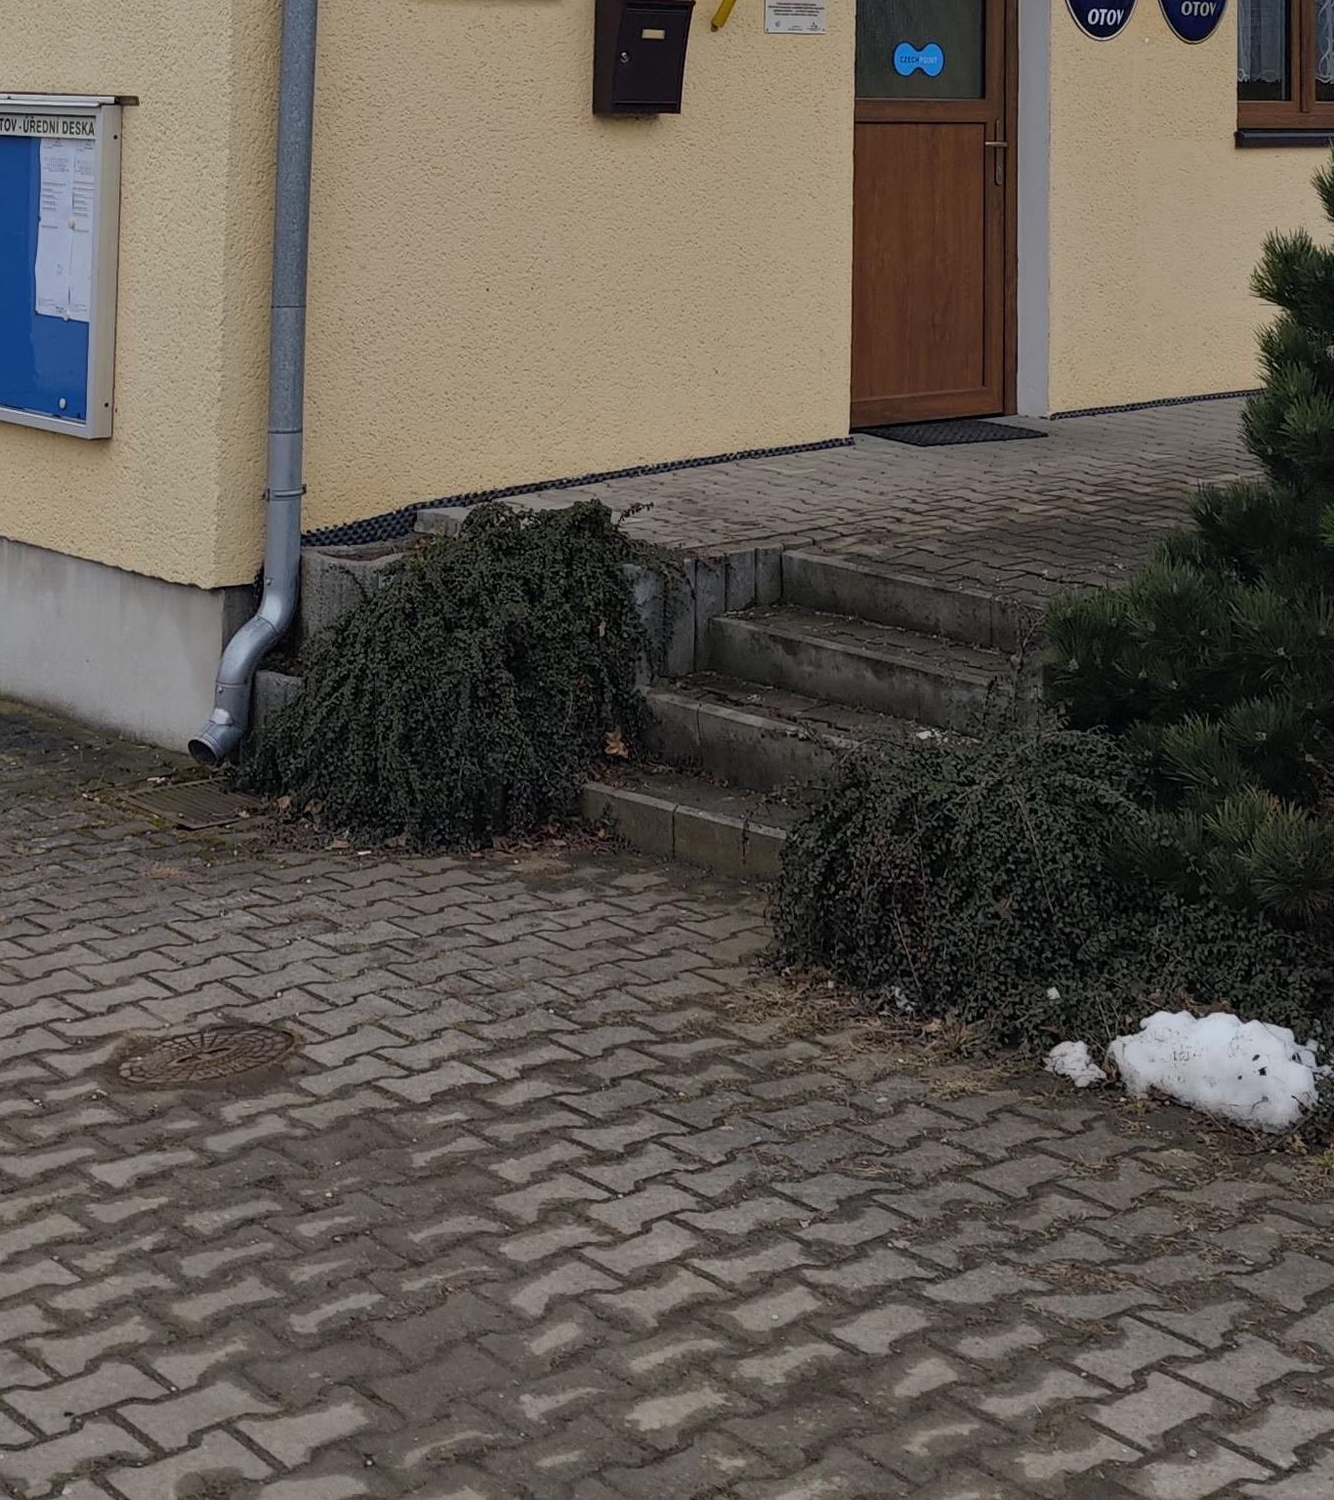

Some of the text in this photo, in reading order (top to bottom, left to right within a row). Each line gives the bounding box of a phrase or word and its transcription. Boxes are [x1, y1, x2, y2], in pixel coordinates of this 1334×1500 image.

[1087, 8, 1125, 26] OTOV
[1180, 0, 1217, 17] OTOV
[61, 120, 95, 136] DESKA
